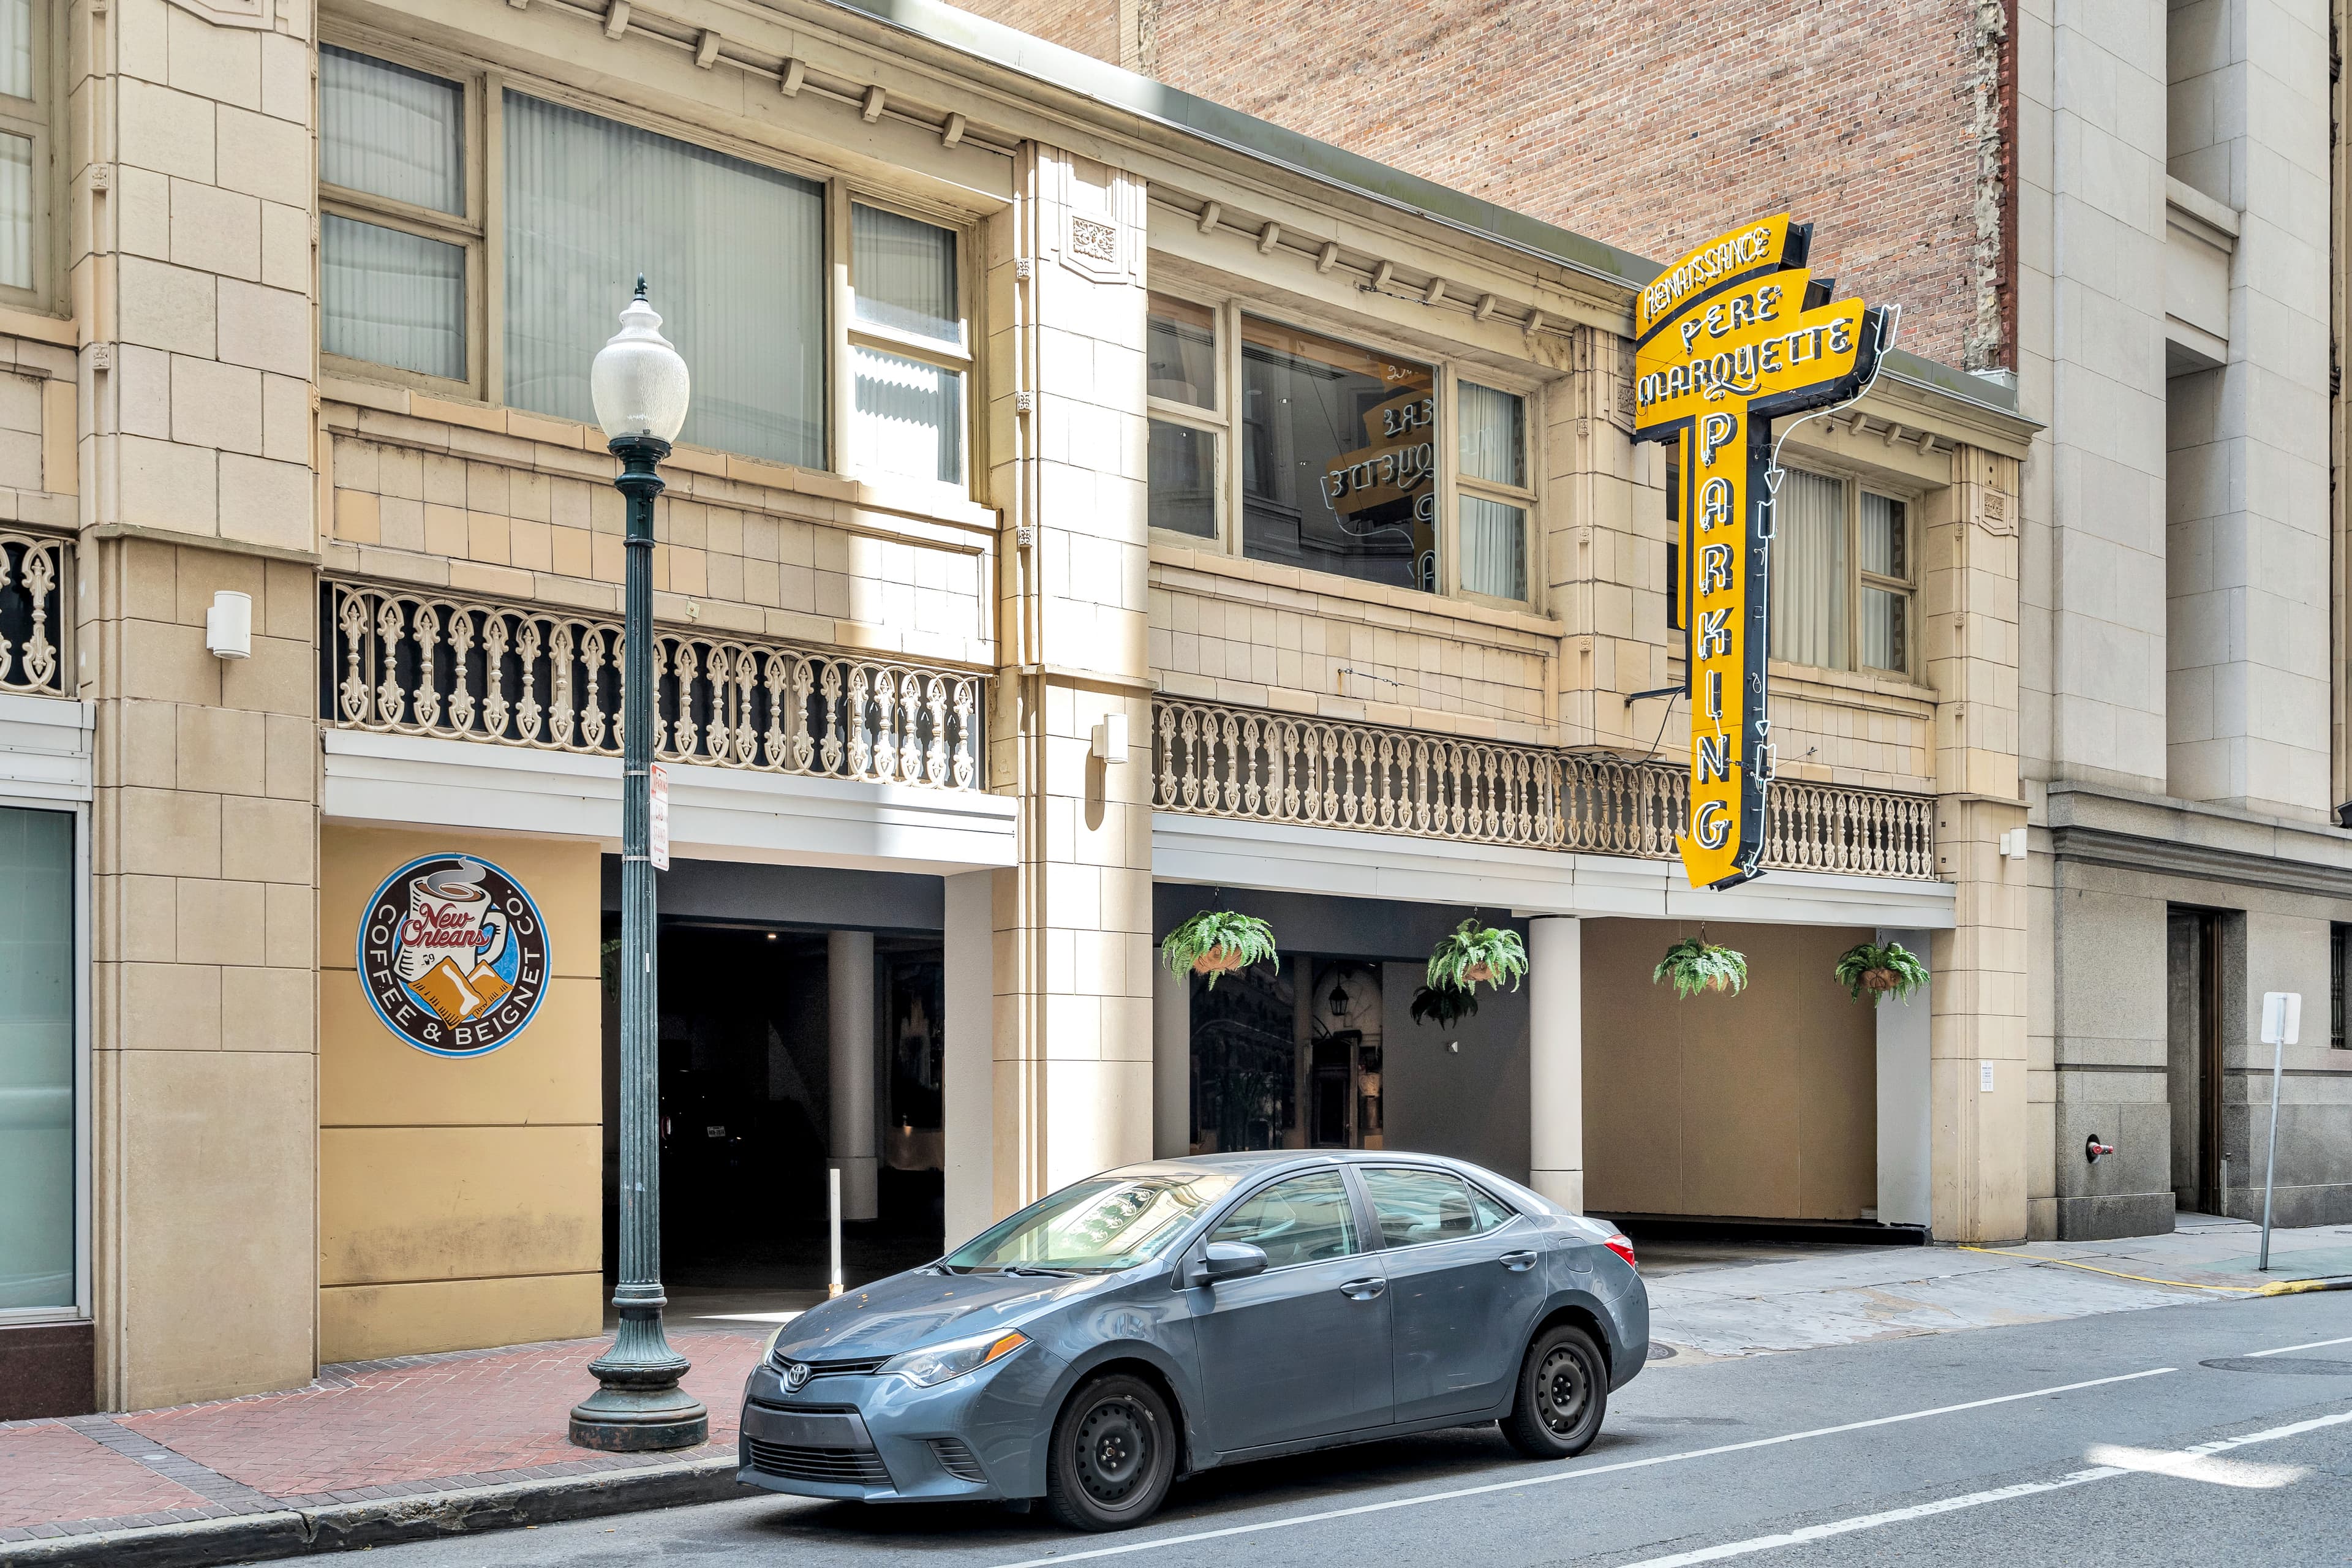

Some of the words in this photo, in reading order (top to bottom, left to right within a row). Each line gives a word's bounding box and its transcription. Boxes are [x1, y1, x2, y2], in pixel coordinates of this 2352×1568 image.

[1643, 227, 1771, 323] RENAISSANCE
[1681, 285, 1782, 354] PERE
[1638, 318, 1853, 407] MARQUETTE
[1693, 412, 1738, 850] PARKING
[400, 919, 491, 948] Orleans
[419, 903, 476, 929] New
[370, 904, 417, 1027] COFFEE
[423, 1023, 442, 1042] &
[455, 947, 540, 1045] BEIGNET
[506, 889, 534, 935] CO.
